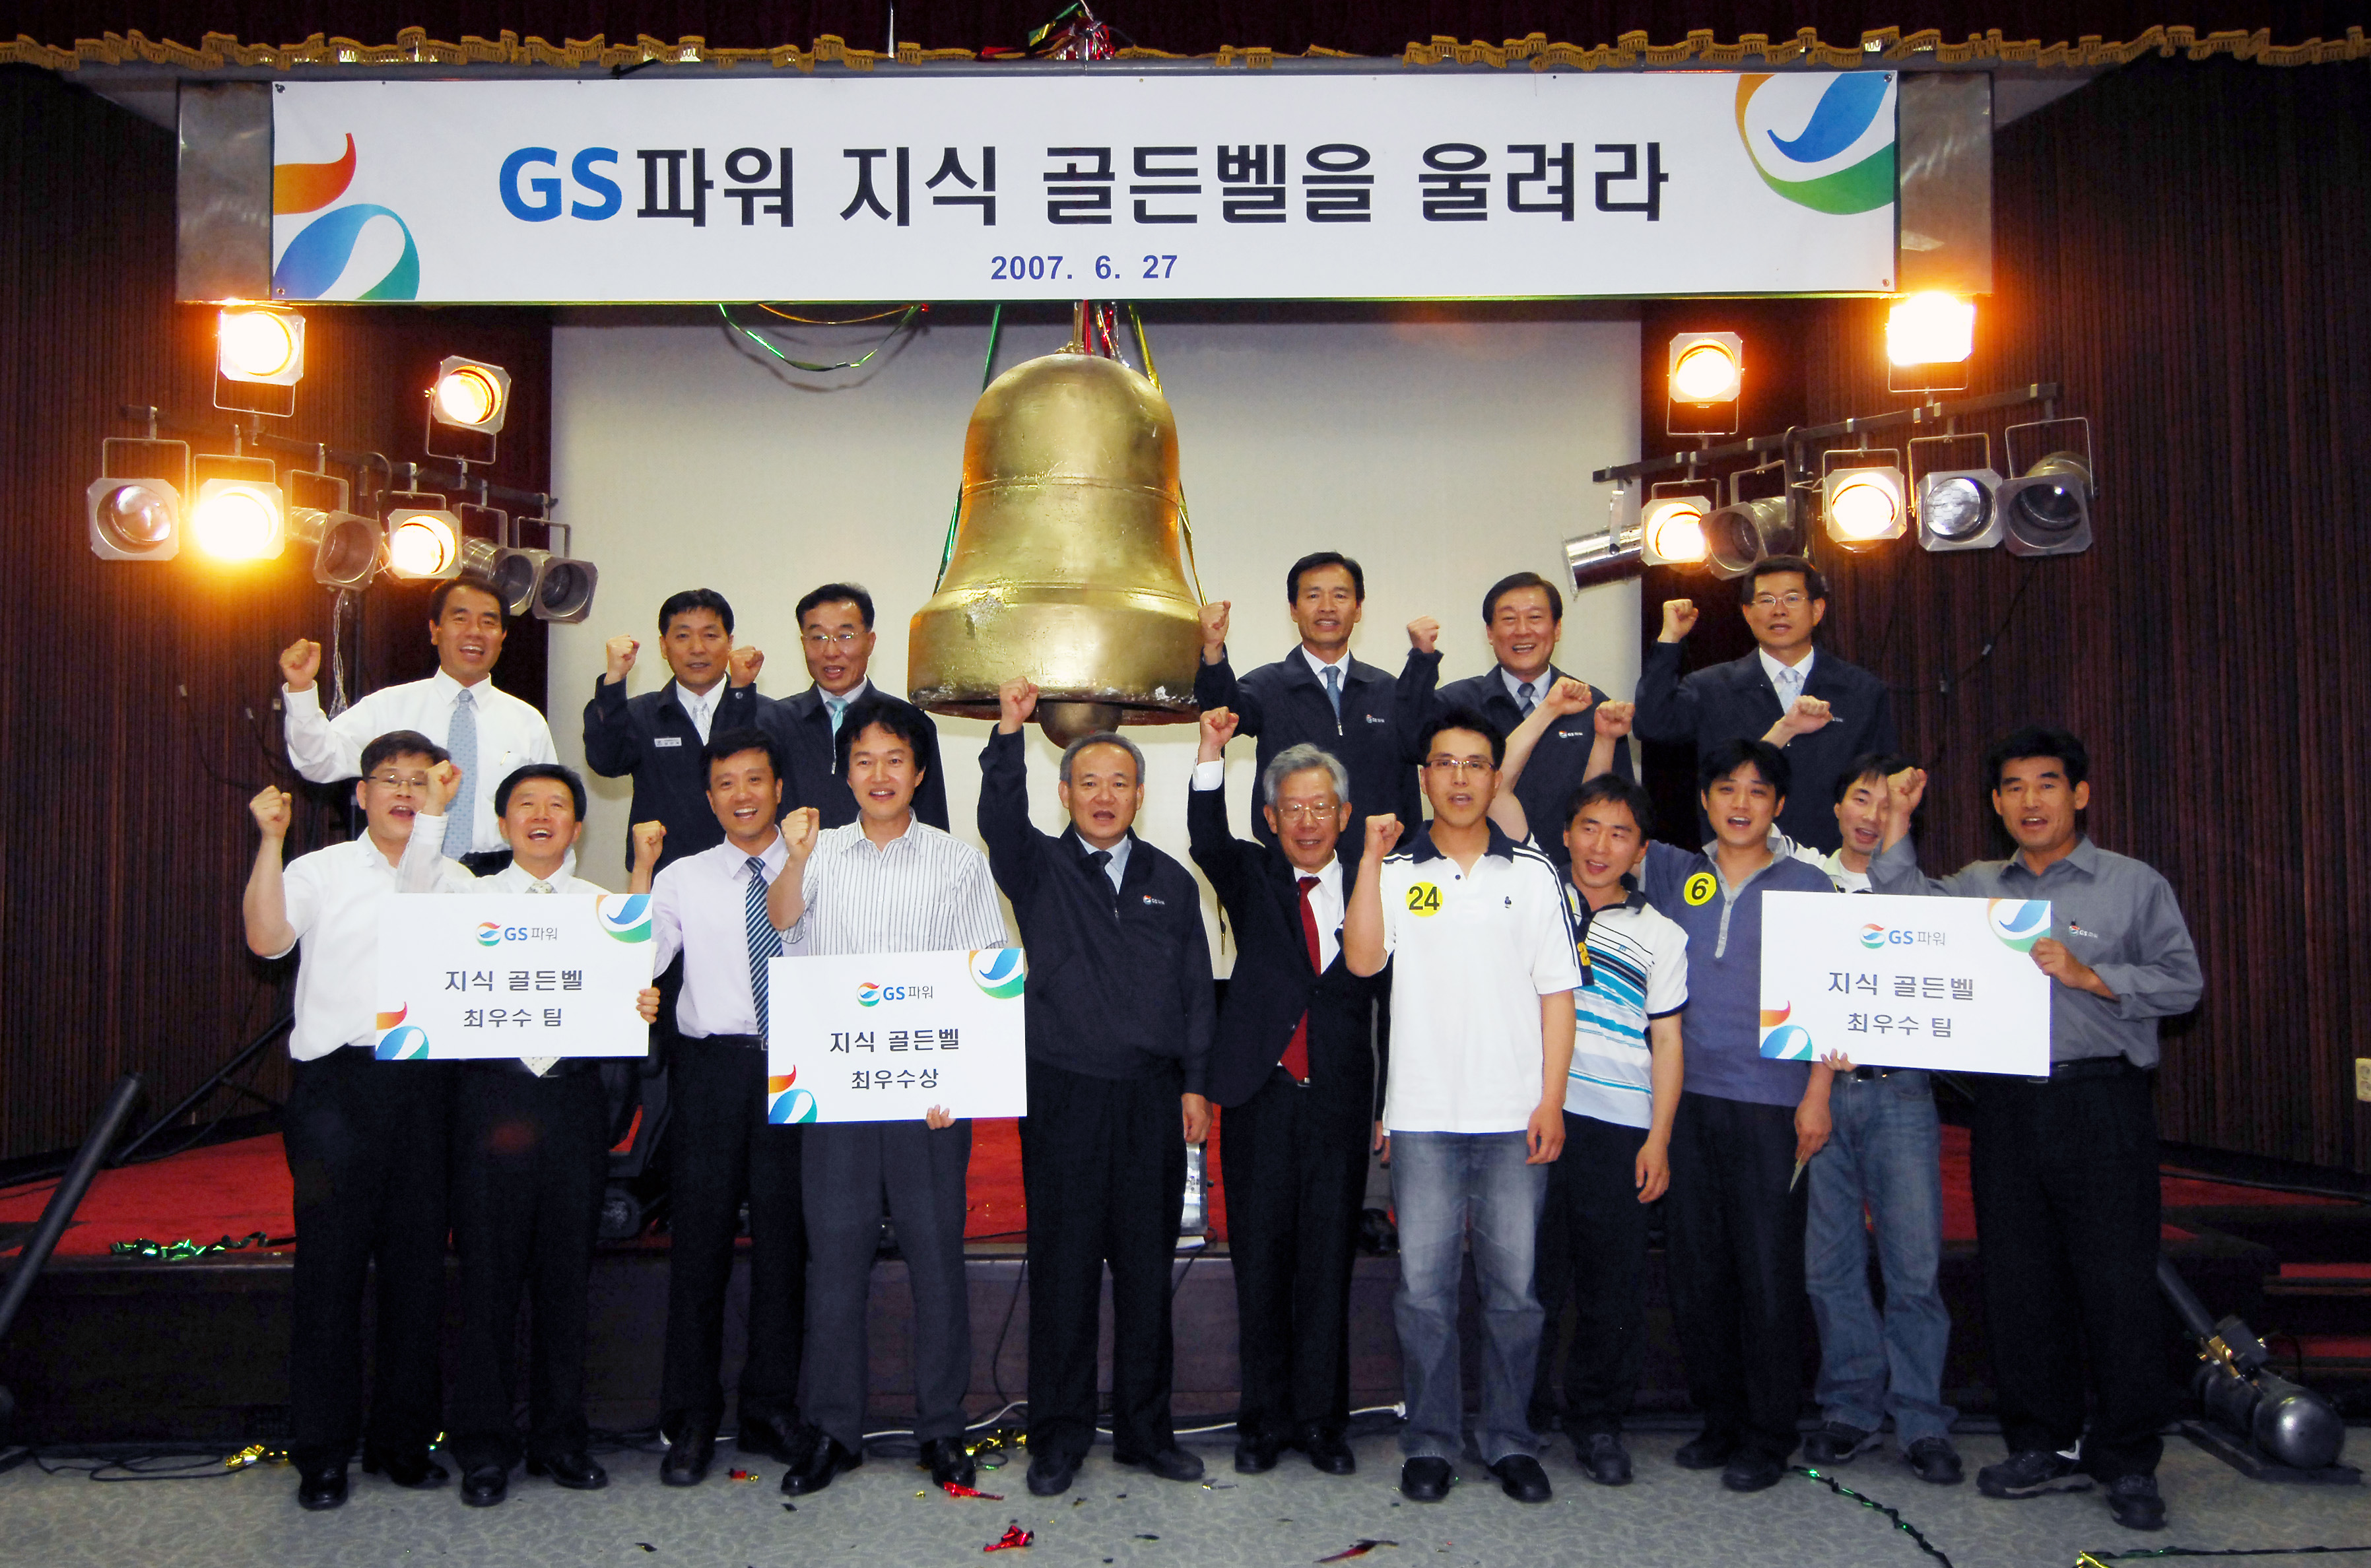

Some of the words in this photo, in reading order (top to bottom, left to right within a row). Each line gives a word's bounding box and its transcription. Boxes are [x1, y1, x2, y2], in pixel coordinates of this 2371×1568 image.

[499, 146, 794, 228] GS파워
[839, 146, 997, 227] 지식
[1043, 143, 1375, 225] 골든벨을
[1418, 141, 1669, 222] 울려라
[991, 255, 1073, 280] 2007.
[1095, 255, 1120, 280] 6.
[1143, 254, 1178, 279] 27
[1409, 886, 1440, 911] 24
[1692, 878, 1709, 900] 6
[444, 970, 493, 992] 지식
[508, 969, 582, 991] 골든벨
[1828, 972, 1878, 996] 지식
[1893, 975, 1974, 1001] 골든벨
[463, 1008, 532, 1028] 최우수
[543, 1008, 562, 1027] 팀
[1848, 1012, 1919, 1035] 최우수
[1931, 1018, 1952, 1038] 팀
[830, 1031, 875, 1054] 지식
[888, 1028, 960, 1052] 골든벨
[852, 1068, 939, 1090] 최우수상
